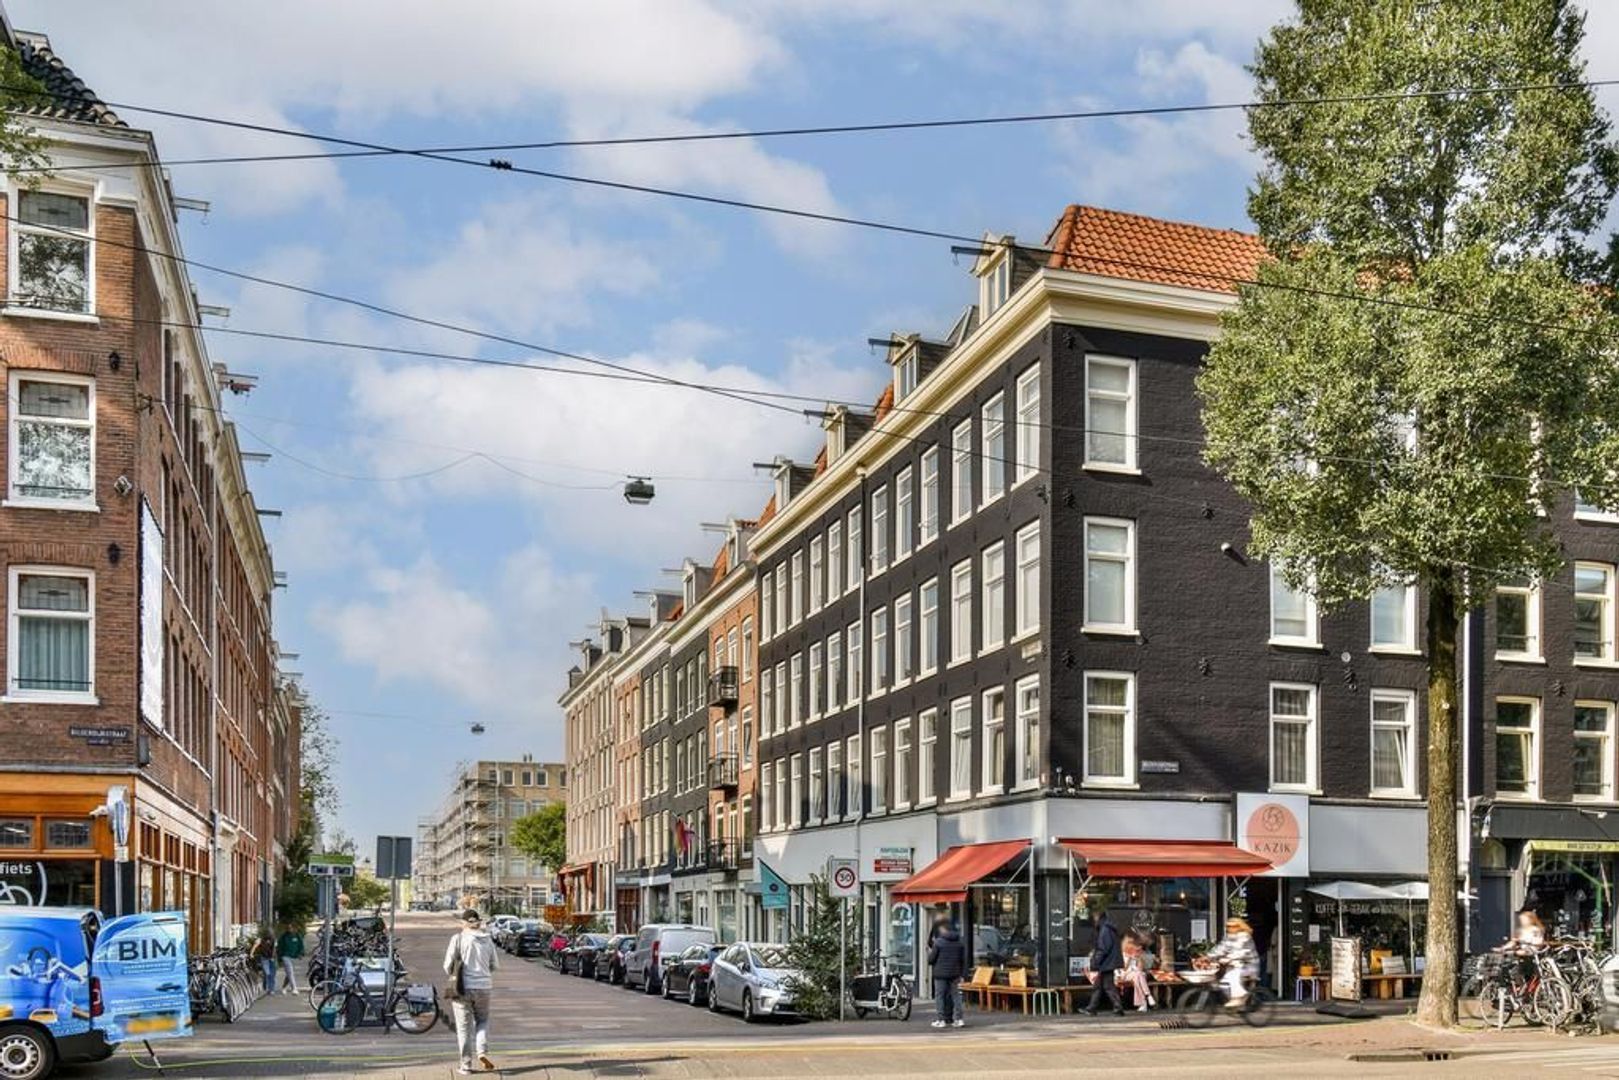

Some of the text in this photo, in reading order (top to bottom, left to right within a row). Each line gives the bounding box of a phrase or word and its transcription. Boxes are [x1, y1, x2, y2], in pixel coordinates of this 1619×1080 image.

[1254, 842, 1291, 853] KAZIK
[839, 872, 852, 882] 30
[118, 938, 177, 961] BIM
